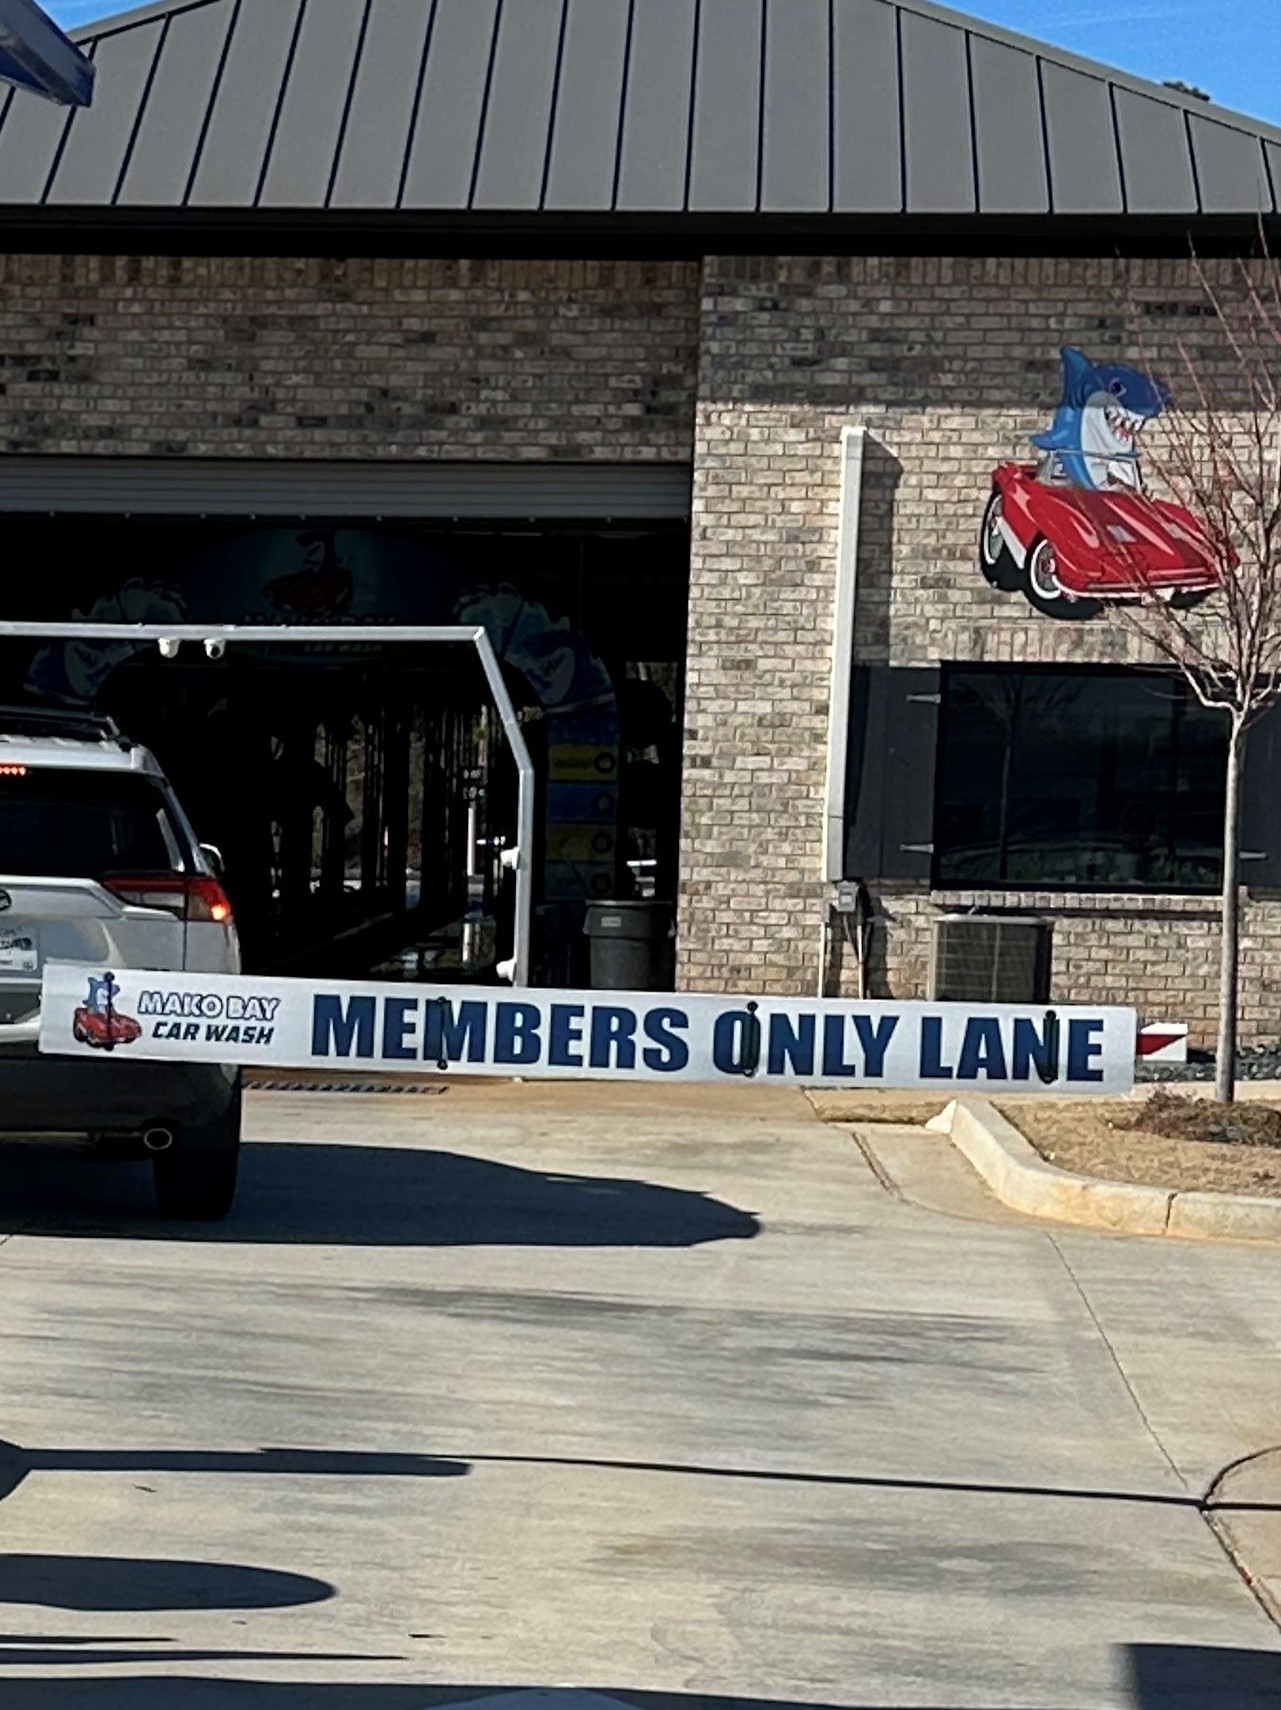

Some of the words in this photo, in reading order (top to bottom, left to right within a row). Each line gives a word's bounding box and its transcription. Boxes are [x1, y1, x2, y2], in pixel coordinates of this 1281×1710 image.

[138, 991, 224, 1018] MAKO
[227, 996, 281, 1020] BAY
[152, 1021, 200, 1041] CAR
[205, 1024, 275, 1045] WASH
[311, 993, 689, 1072] MEMBERS
[713, 1009, 900, 1077] ONLY
[920, 1015, 1104, 1081] LANE
